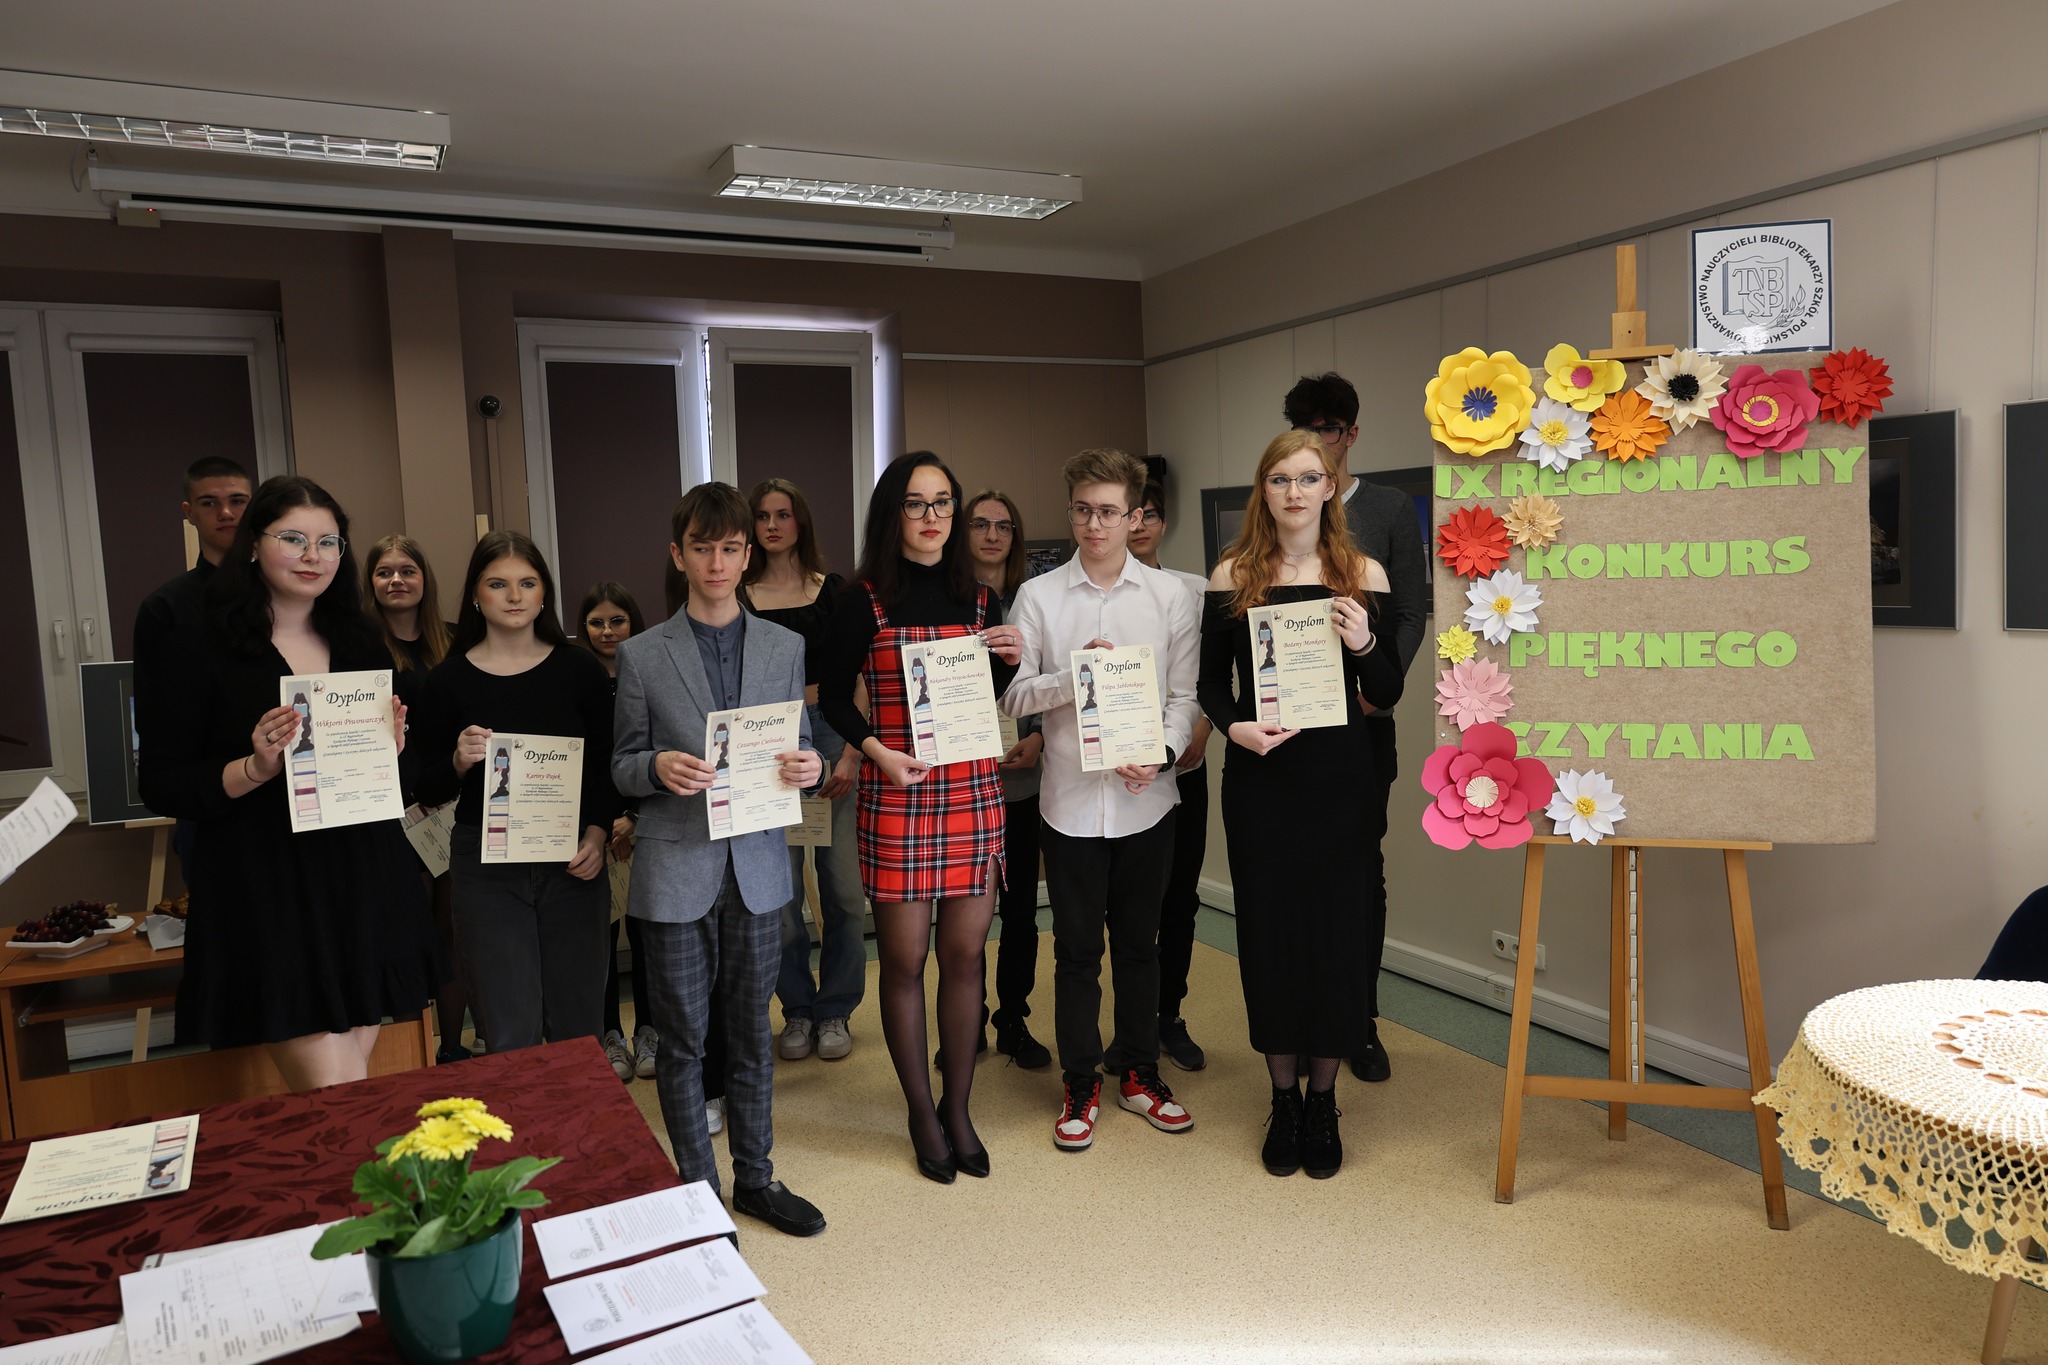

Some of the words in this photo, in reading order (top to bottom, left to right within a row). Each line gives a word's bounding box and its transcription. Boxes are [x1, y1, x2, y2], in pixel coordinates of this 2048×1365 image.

[1704, 235, 1757, 282] NAUCZYCIELI
[1760, 234, 1824, 285] BIBLIOTEKARZY
[1804, 287, 1824, 318] SZKÓŁ
[1434, 463, 1496, 499] IX
[1500, 446, 1866, 497] REGIONALNY
[1526, 535, 1811, 580] KONKURS
[1284, 616, 1325, 632] Dyplom
[936, 651, 975, 667] Dyplom
[1508, 630, 1798, 678] PIĘKNEGO
[1104, 660, 1141, 675] Dyplom
[326, 688, 376, 707] Dyplom
[743, 715, 785, 731] Dyplom
[523, 750, 568, 763] Dyplom
[35, 1191, 119, 1212] Dyplom
